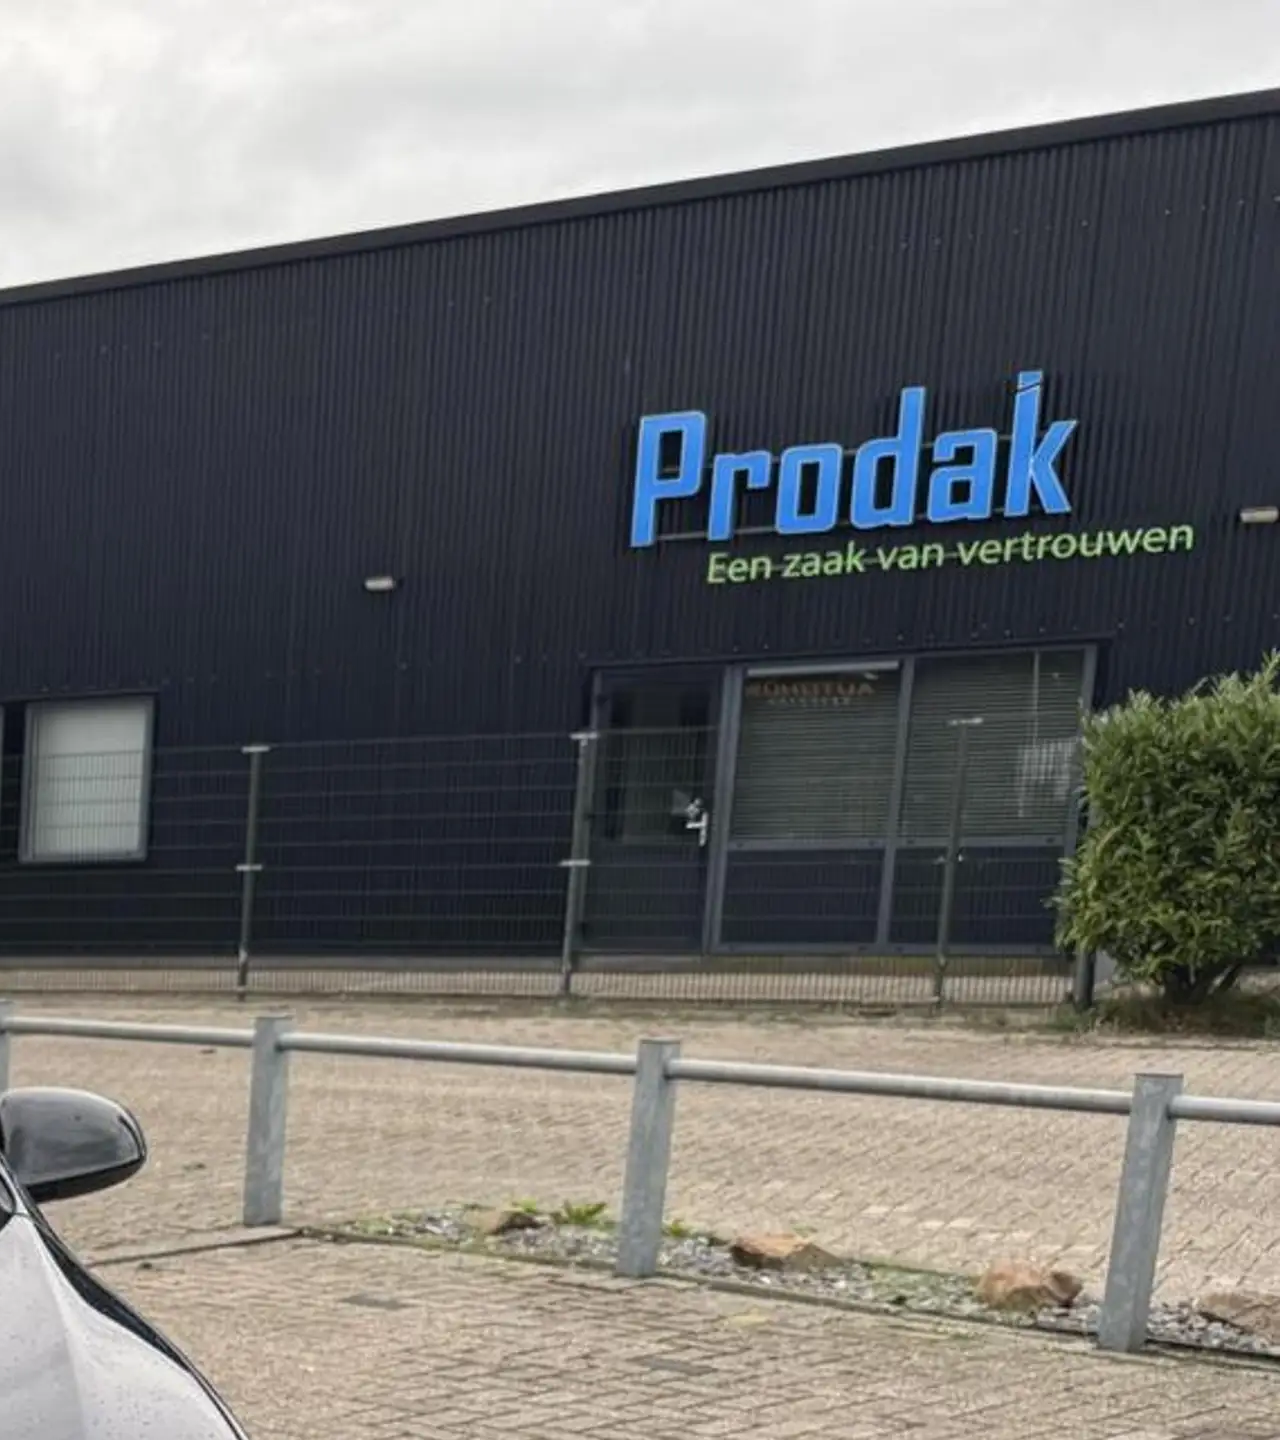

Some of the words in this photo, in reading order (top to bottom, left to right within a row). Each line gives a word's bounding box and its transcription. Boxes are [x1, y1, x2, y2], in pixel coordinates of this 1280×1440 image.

[630, 370, 1078, 548] Prodak
[706, 551, 774, 584] Een
[780, 540, 866, 578] zaak
[876, 541, 945, 571] van
[957, 523, 1194, 567] vertrouwen
